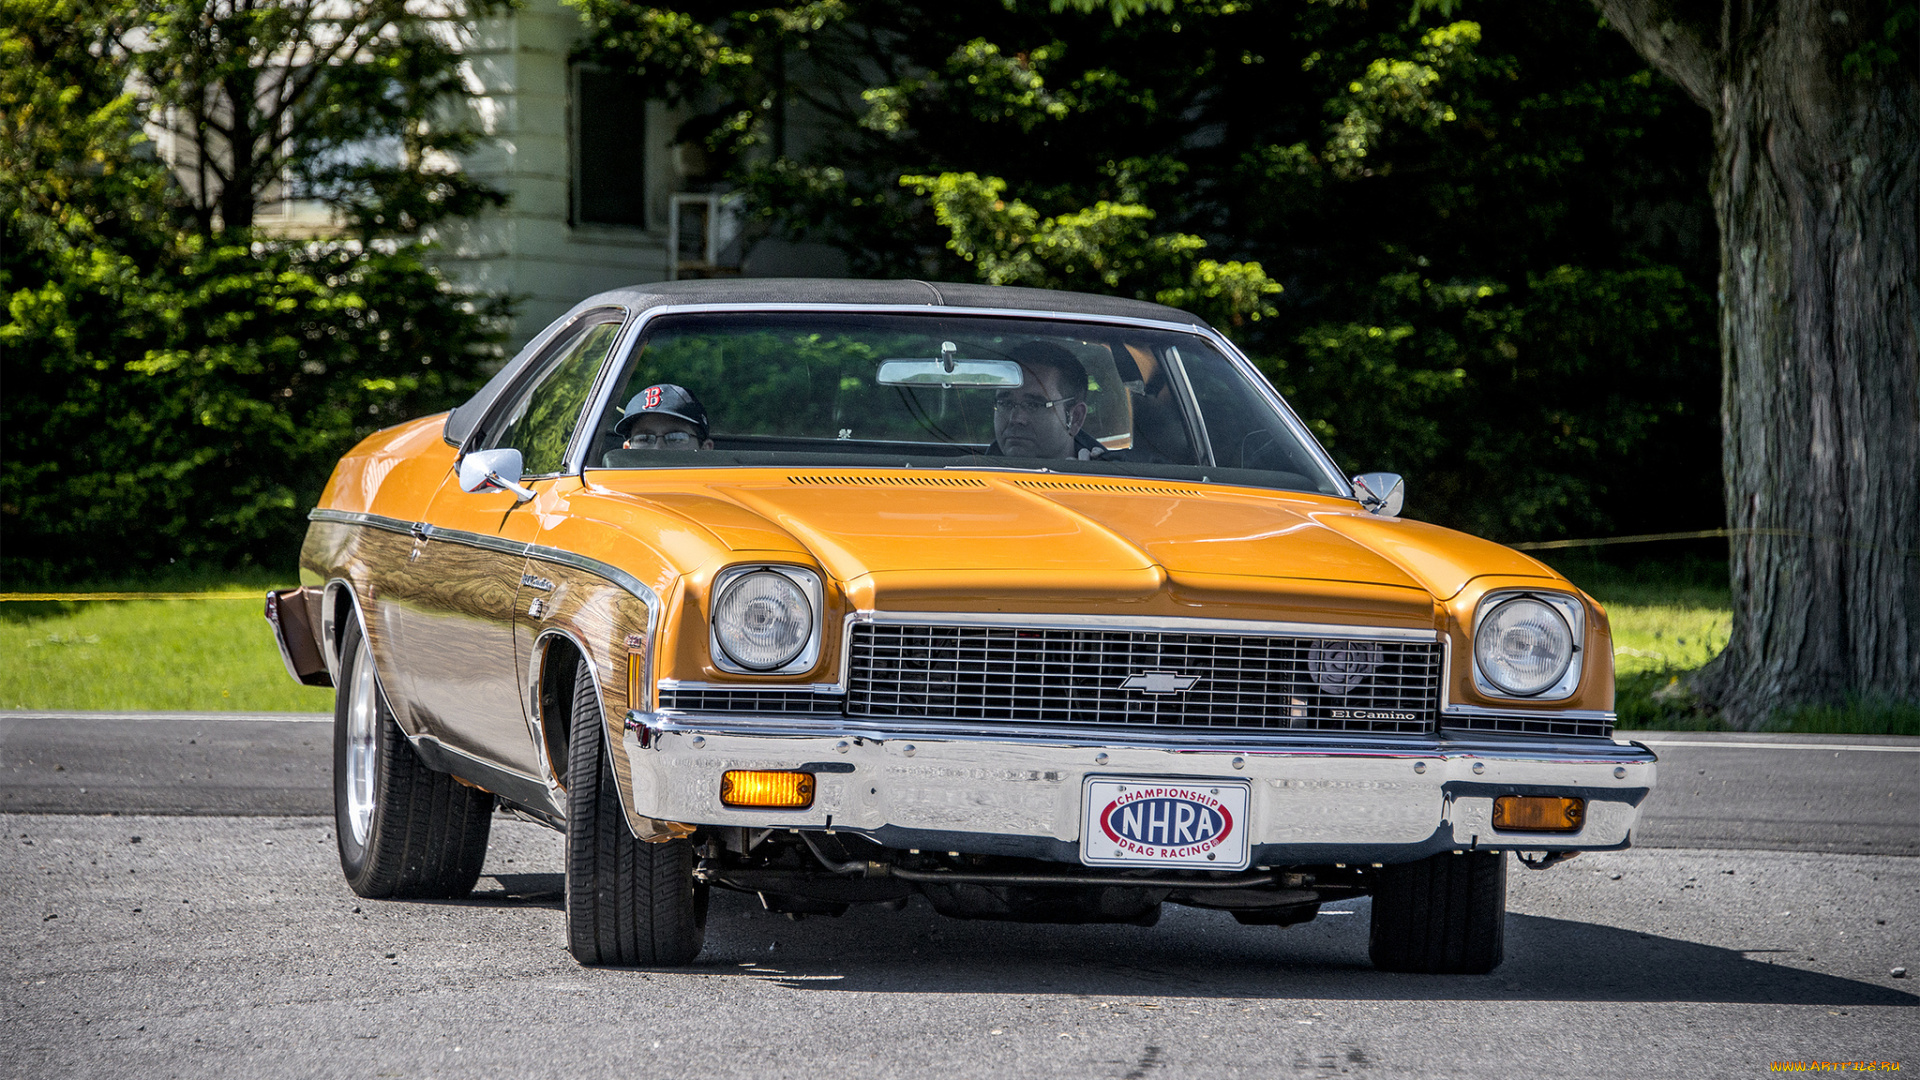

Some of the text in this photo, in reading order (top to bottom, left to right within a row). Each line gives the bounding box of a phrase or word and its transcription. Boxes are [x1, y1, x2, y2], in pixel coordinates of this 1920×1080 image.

[642, 386, 663, 410] B
[1331, 710, 1416, 721] El Camino
[1116, 788, 1219, 808] CHAMPIONSHIP
[1122, 801, 1215, 844] NHRA
[1118, 838, 1211, 858] DRAG RACING
